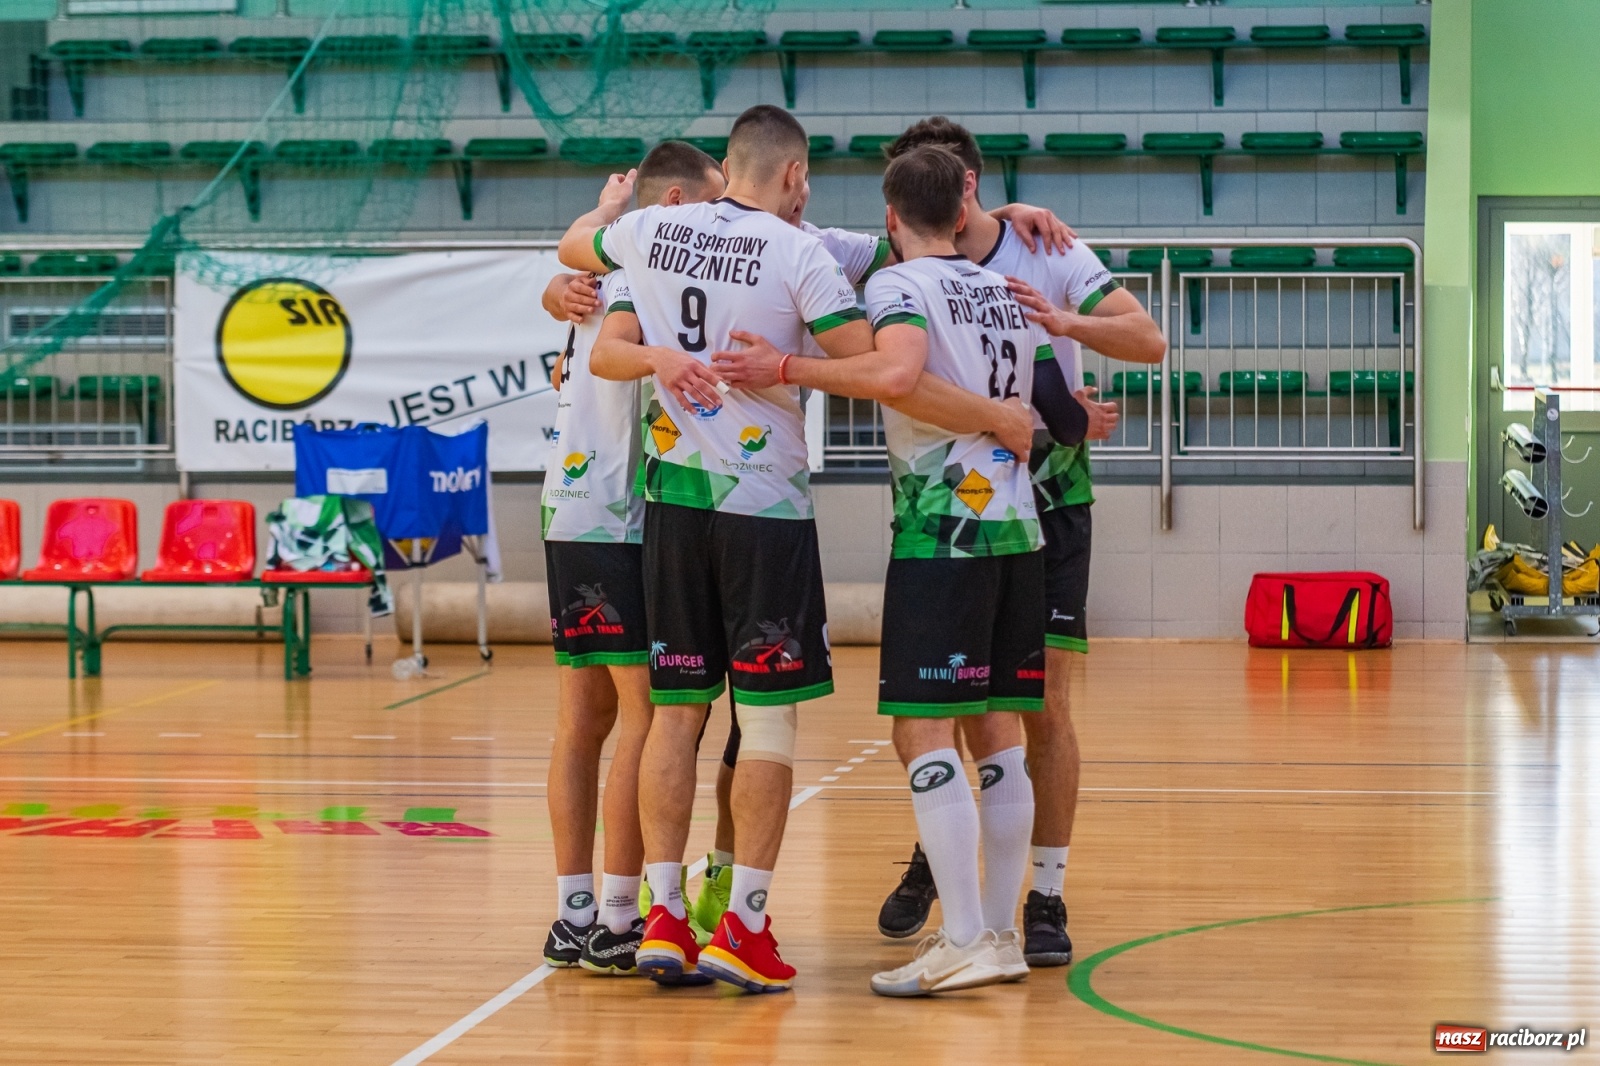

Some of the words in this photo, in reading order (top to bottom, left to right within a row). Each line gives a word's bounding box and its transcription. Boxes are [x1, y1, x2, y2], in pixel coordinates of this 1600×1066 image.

[654, 222, 694, 245] KLUB
[647, 242, 762, 287] RUDZINIEC
[677, 286, 707, 353] 9
[980, 333, 1020, 401] 22
[388, 374, 476, 429] JEST
[488, 359, 526, 397] W
[549, 489, 591, 499] DZINIEC
[658, 654, 705, 668] BURGER
[918, 667, 953, 680] MIAMI
[957, 665, 991, 680] BURGE
